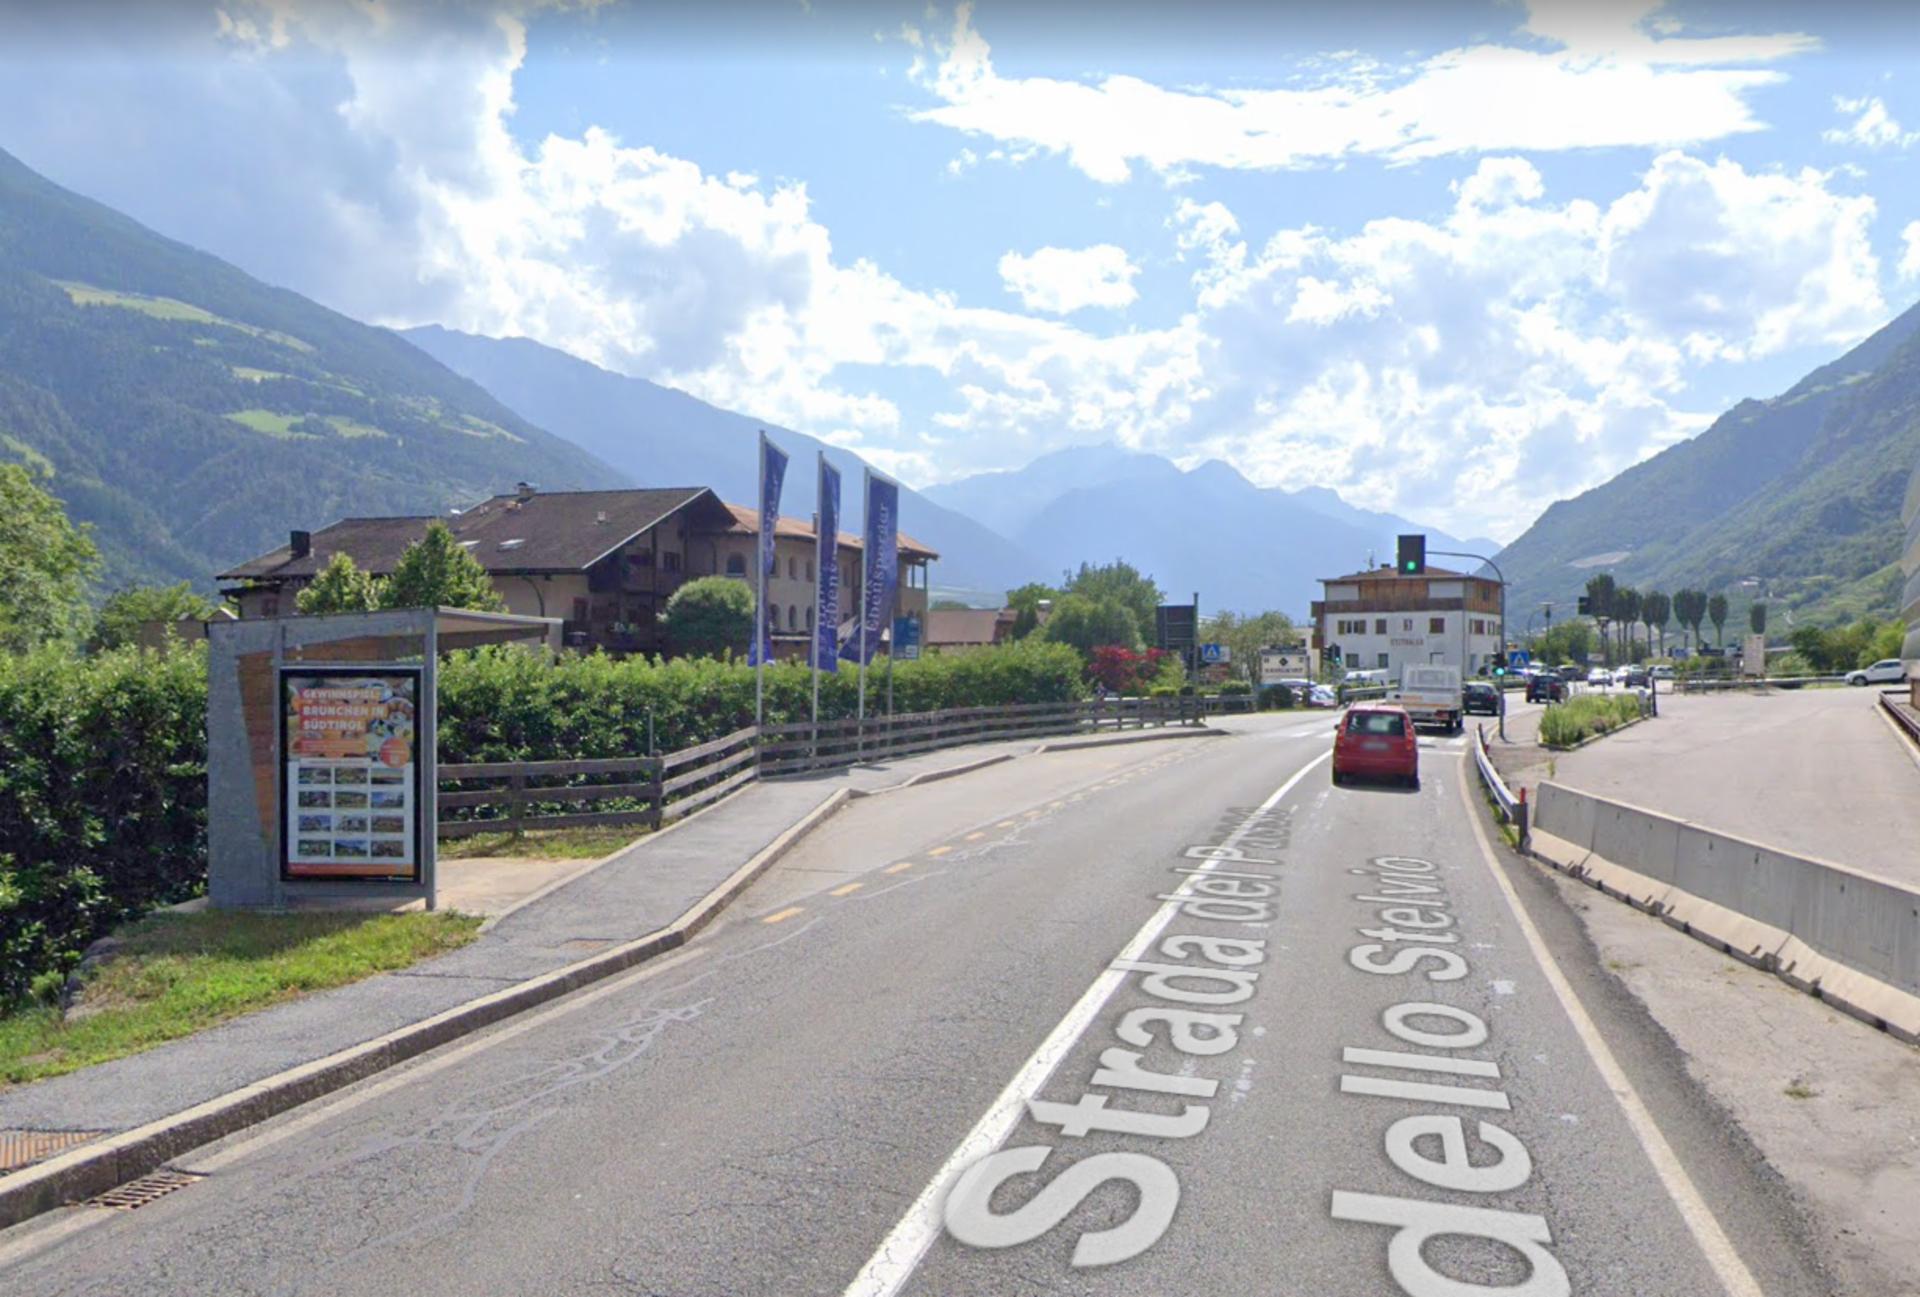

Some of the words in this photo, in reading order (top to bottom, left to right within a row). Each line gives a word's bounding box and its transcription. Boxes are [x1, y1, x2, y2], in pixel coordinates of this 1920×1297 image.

[303, 706, 369, 716] BRUNCHEN
[372, 706, 385, 716] IN
[303, 718, 364, 730] SÜDTIROL
